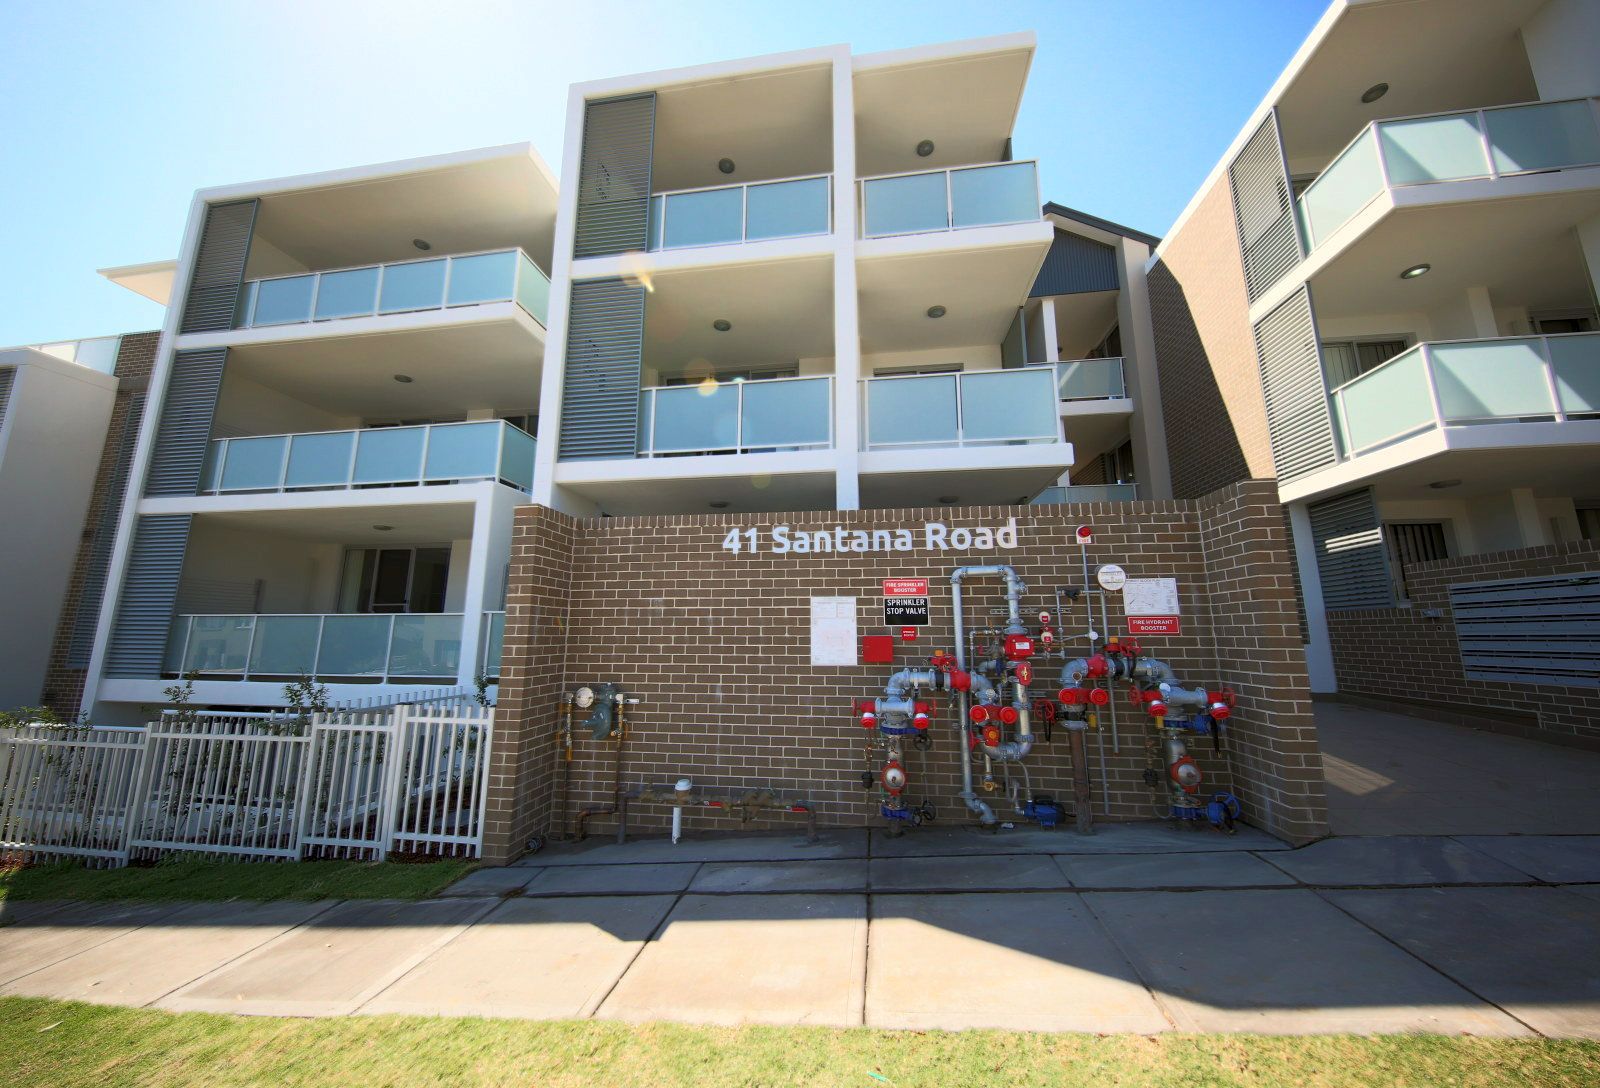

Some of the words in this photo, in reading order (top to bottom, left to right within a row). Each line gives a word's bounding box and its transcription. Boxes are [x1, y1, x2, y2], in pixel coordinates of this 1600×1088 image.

[722, 527, 757, 554] 41
[772, 526, 912, 553] Santana
[925, 518, 1017, 550] Road
